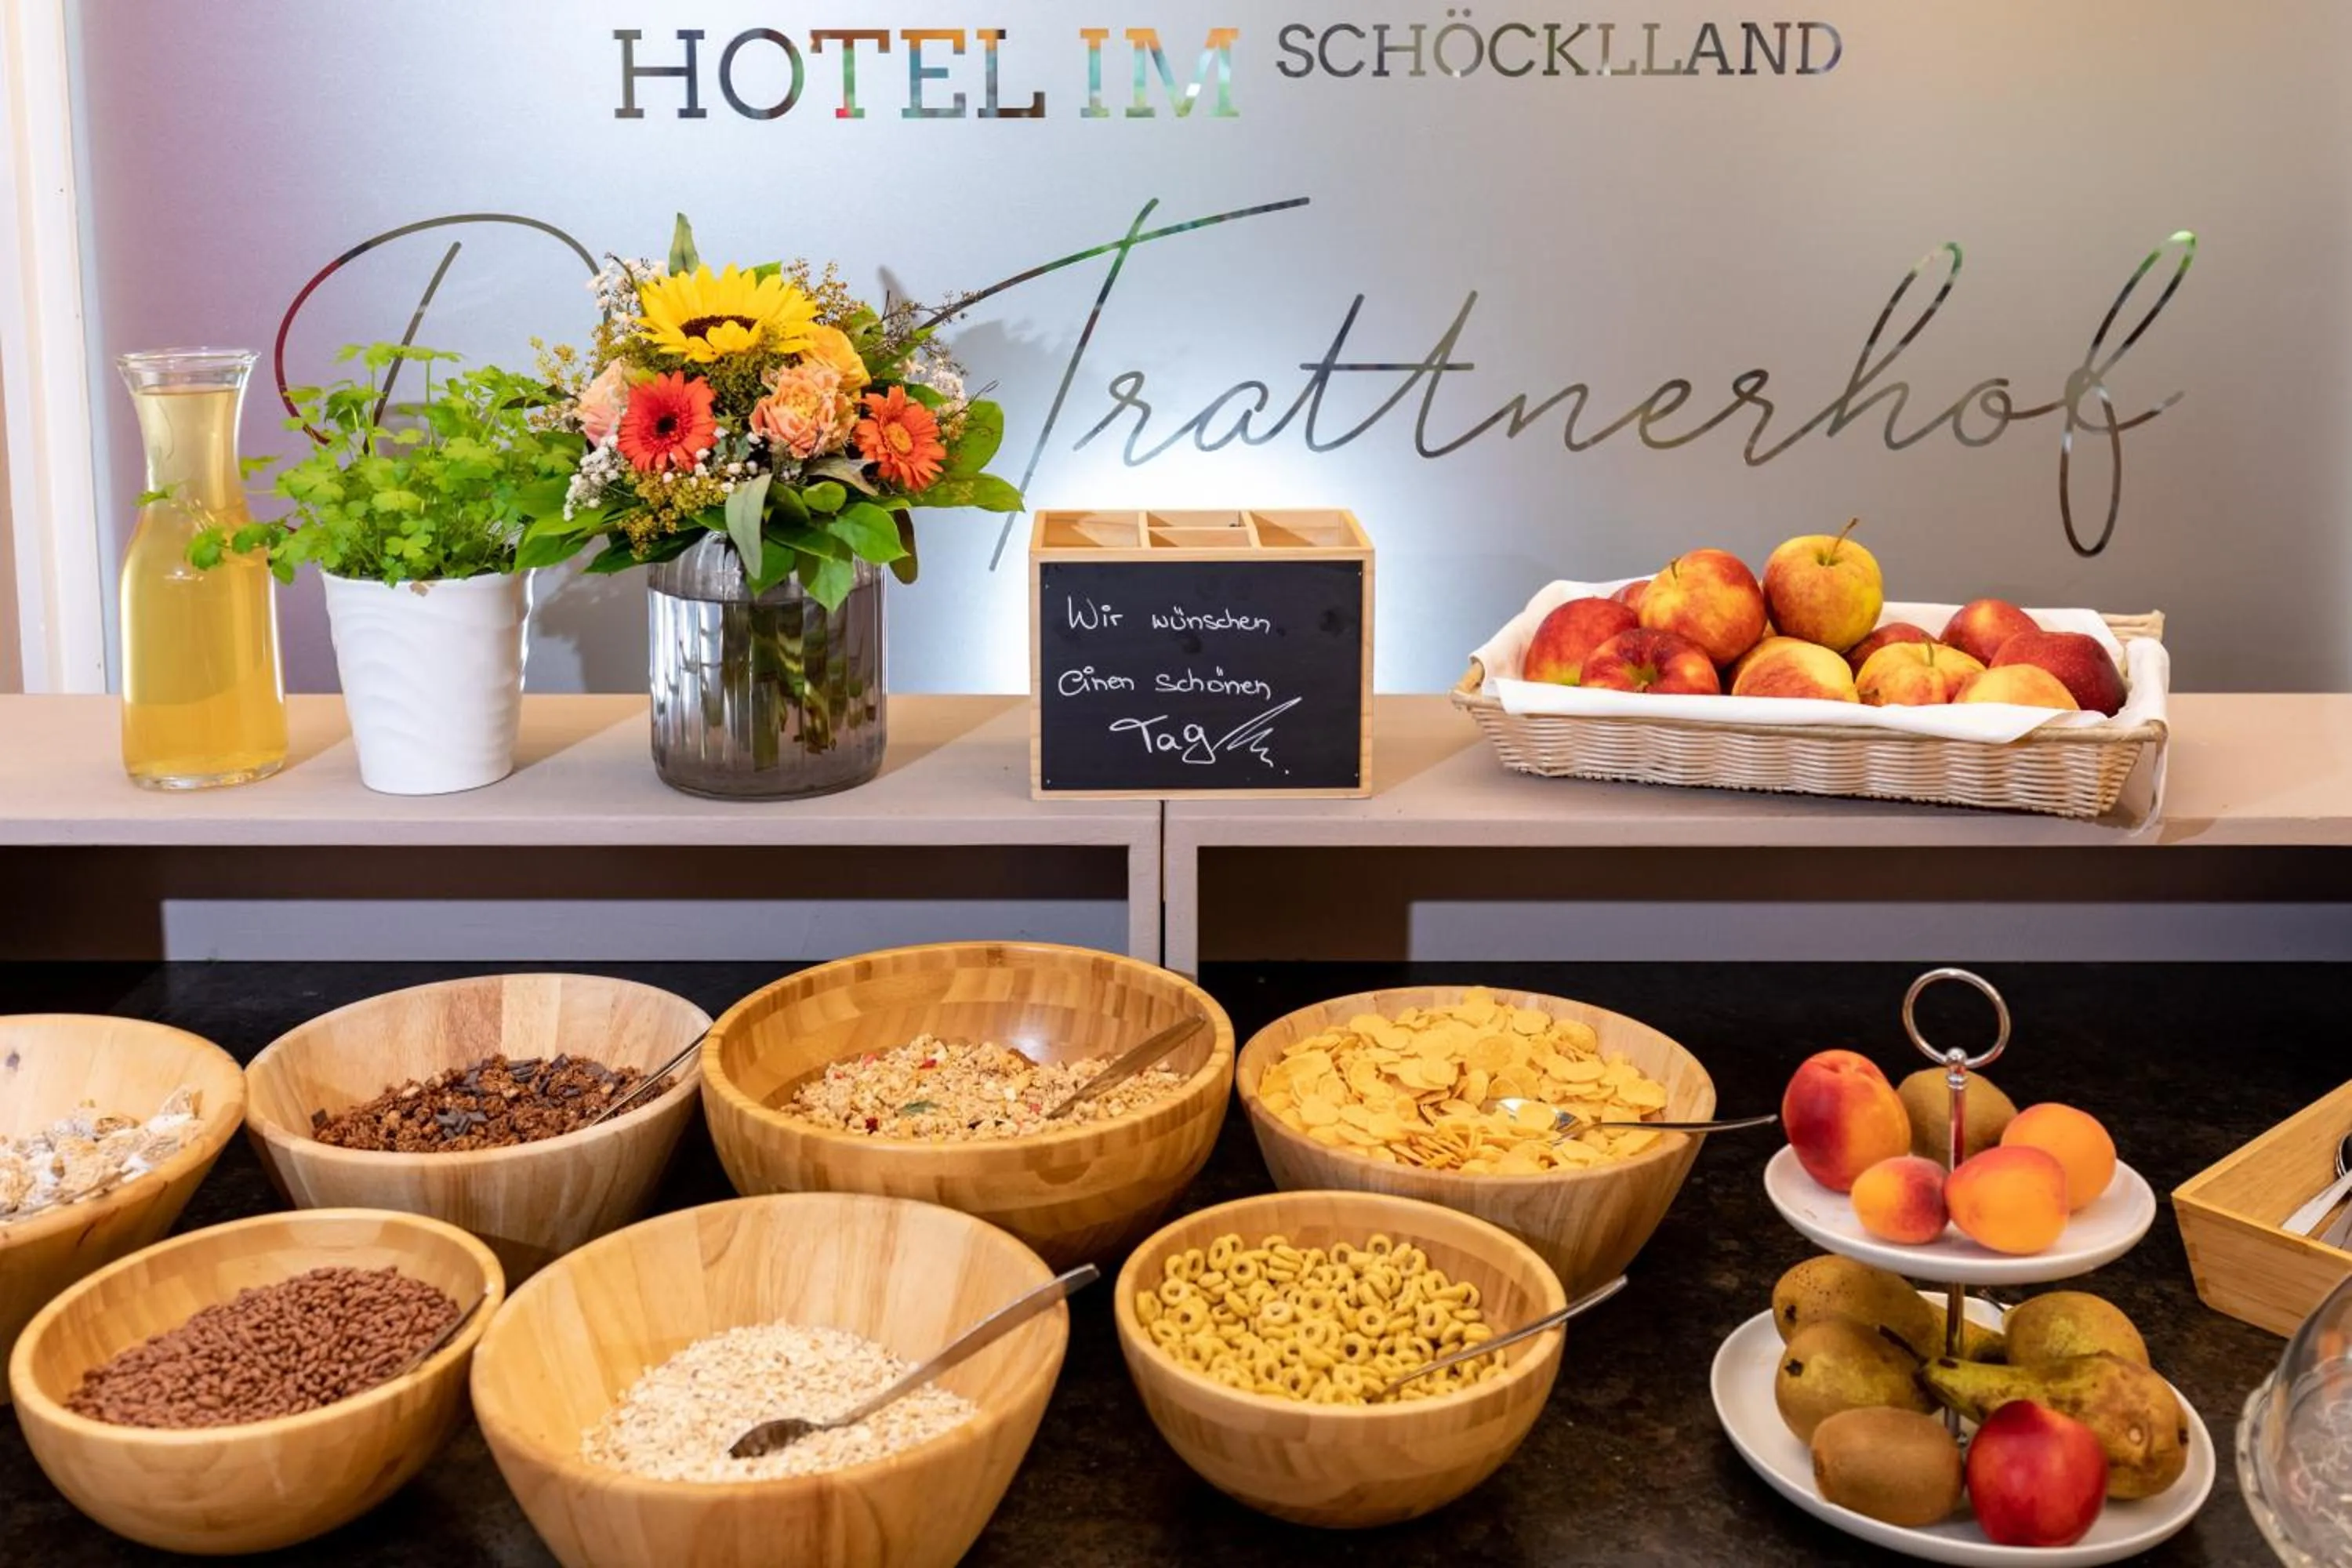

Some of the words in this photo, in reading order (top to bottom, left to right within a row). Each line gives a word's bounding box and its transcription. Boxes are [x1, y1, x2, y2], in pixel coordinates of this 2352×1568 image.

[614, 28, 1045, 119] HOTEL
[1080, 28, 1240, 118] IM
[1276, 9, 1843, 77] SCHÖCKLLAND
[919, 196, 2198, 572] Trattnerhof
[1068, 596, 1123, 630] Wir
[1152, 606, 1272, 634] wünschen
[1109, 715, 1217, 765] Tag
